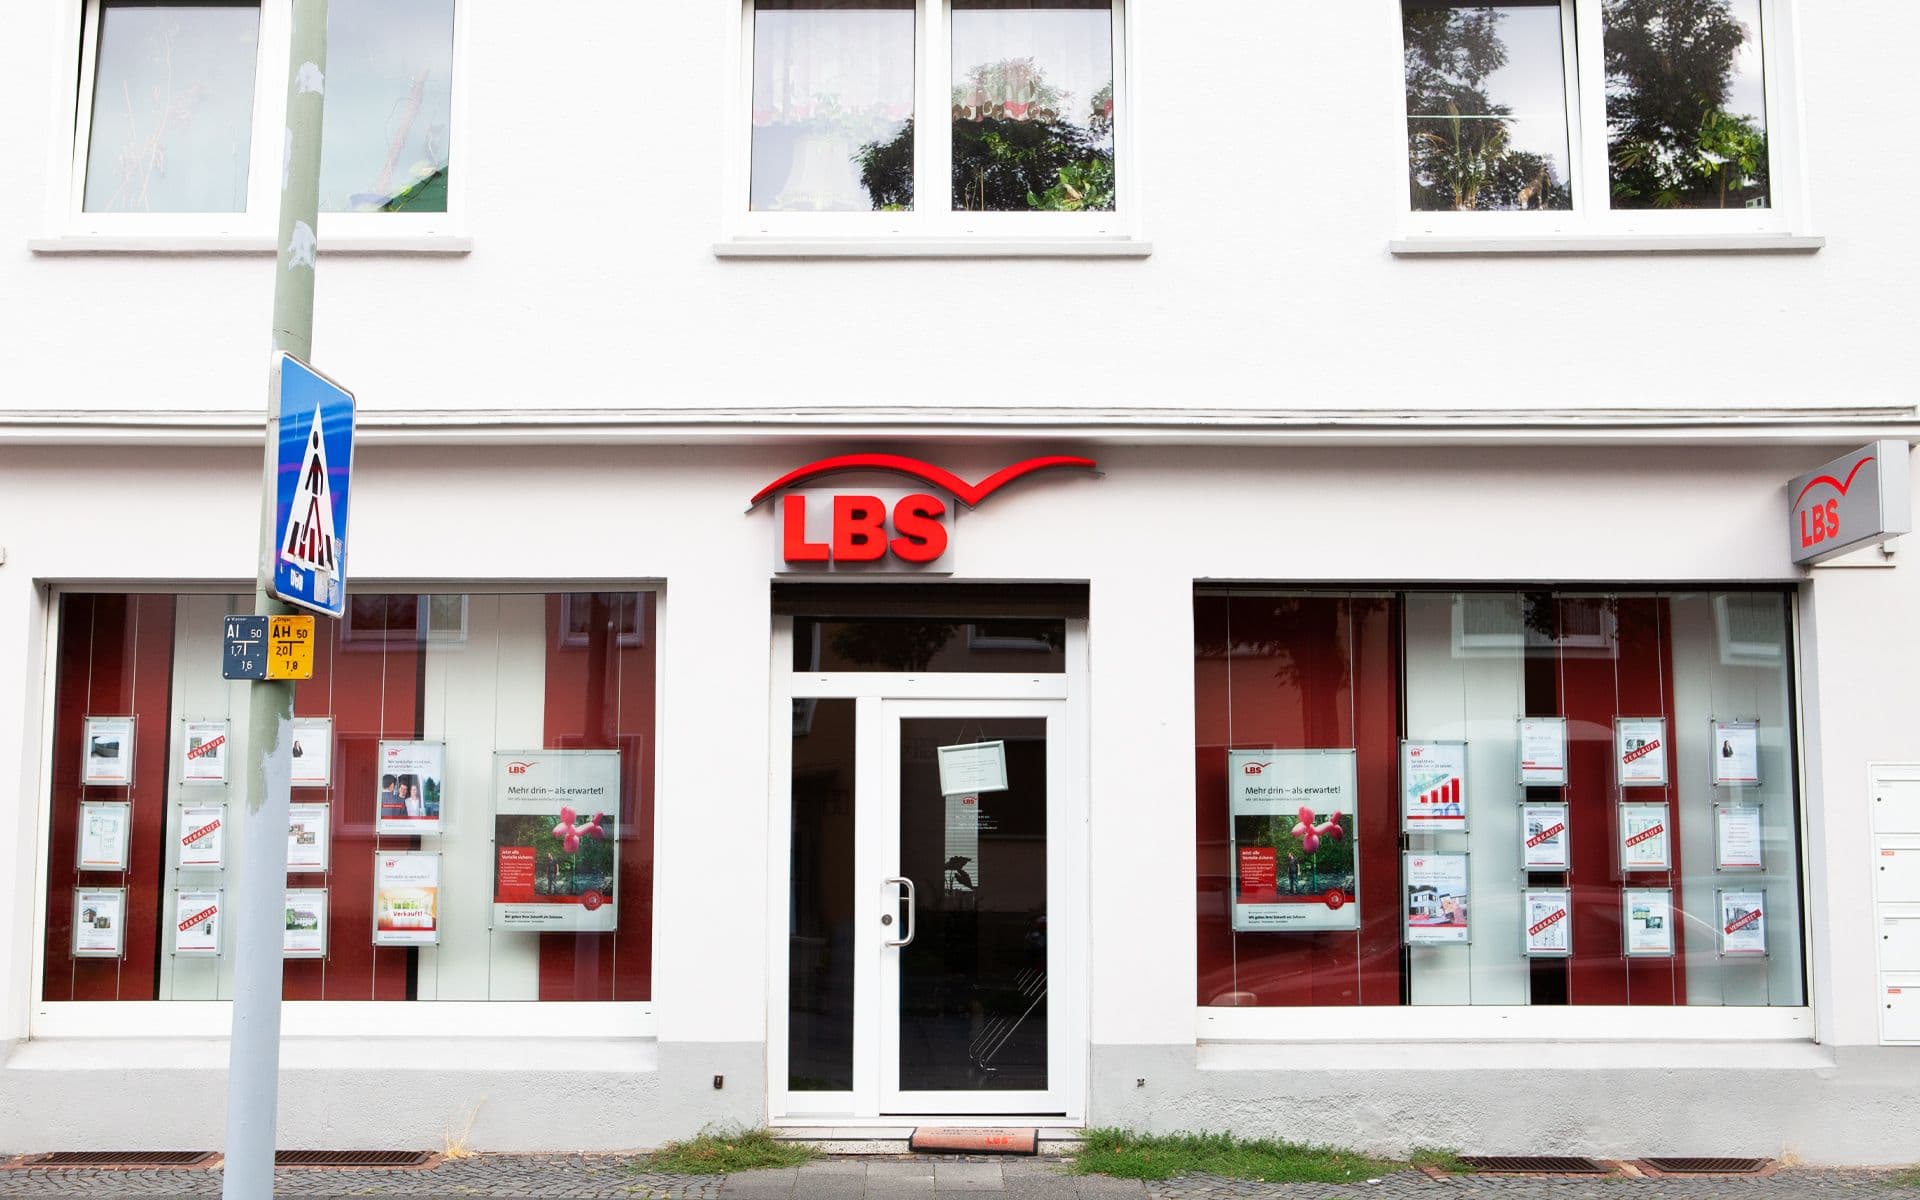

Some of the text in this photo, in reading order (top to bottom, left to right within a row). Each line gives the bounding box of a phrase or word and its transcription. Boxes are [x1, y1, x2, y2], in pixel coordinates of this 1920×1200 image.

[784, 493, 948, 563] LBS
[1802, 499, 1839, 549] LBS
[250, 629, 262, 639] 50
[273, 624, 308, 639] AH 50
[188, 735, 225, 760] VERKAUFT
[1624, 740, 1660, 764] VERKAUFT
[508, 766, 526, 774] LBS
[1245, 766, 1262, 775] LBS
[507, 786, 529, 795] Mehr
[530, 786, 547, 795] drin
[554, 786, 566, 795] als
[567, 787, 604, 795] erwartet!
[1245, 786, 1266, 795] Mehr
[1268, 786, 1284, 795] drin
[1291, 786, 1303, 795] als
[1304, 786, 1341, 794] erwartet!
[183, 820, 220, 845] VERKAUFT
[1527, 823, 1564, 847] VERKAUFT
[1626, 825, 1664, 848] VERKAUFT
[179, 906, 217, 931] VERKAUFT
[1529, 909, 1566, 935] VERKAUFT
